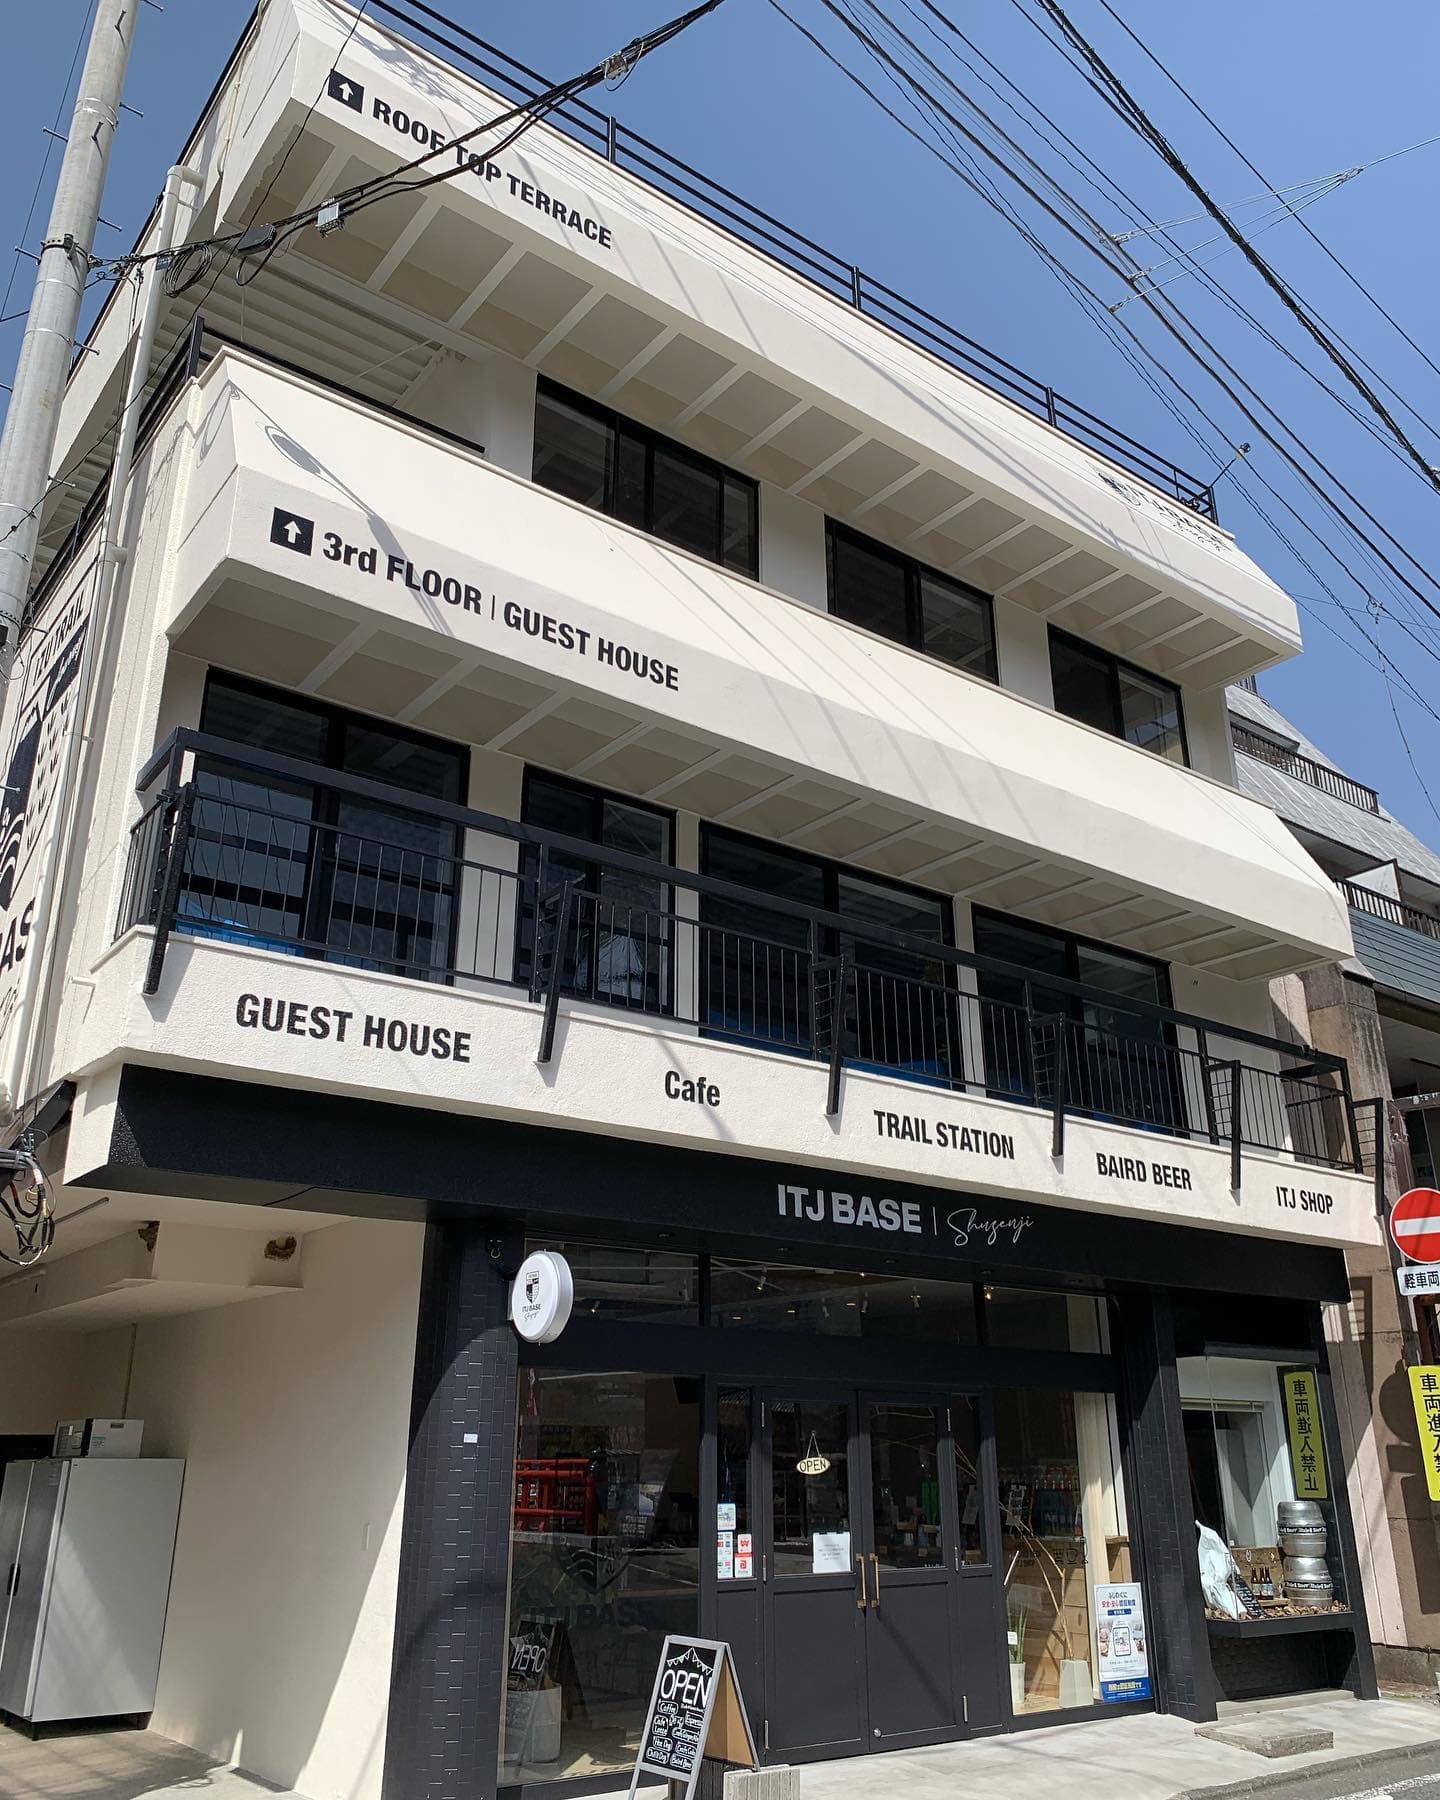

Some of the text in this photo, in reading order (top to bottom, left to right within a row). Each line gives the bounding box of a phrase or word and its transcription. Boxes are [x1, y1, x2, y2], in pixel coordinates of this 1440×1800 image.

[373, 97, 612, 249] ROOF TOP TERRACE
[322, 532, 679, 691] 3rd FLOOR GUEST HOUSE
[235, 992, 471, 1064] GUEST HOUSE
[664, 1070, 721, 1107] Cafe
[873, 1109, 1015, 1160] TRAIL STATION
[1095, 1152, 1193, 1191] BAIRD BEER
[777, 1183, 1034, 1247] ITJ BASE Shuzenji
[1275, 1186, 1334, 1215] ITJ SHOP
[1404, 1271, 1440, 1289] 軽車両
[799, 1460, 827, 1473] OPEN
[661, 1669, 712, 1708] OPEN
